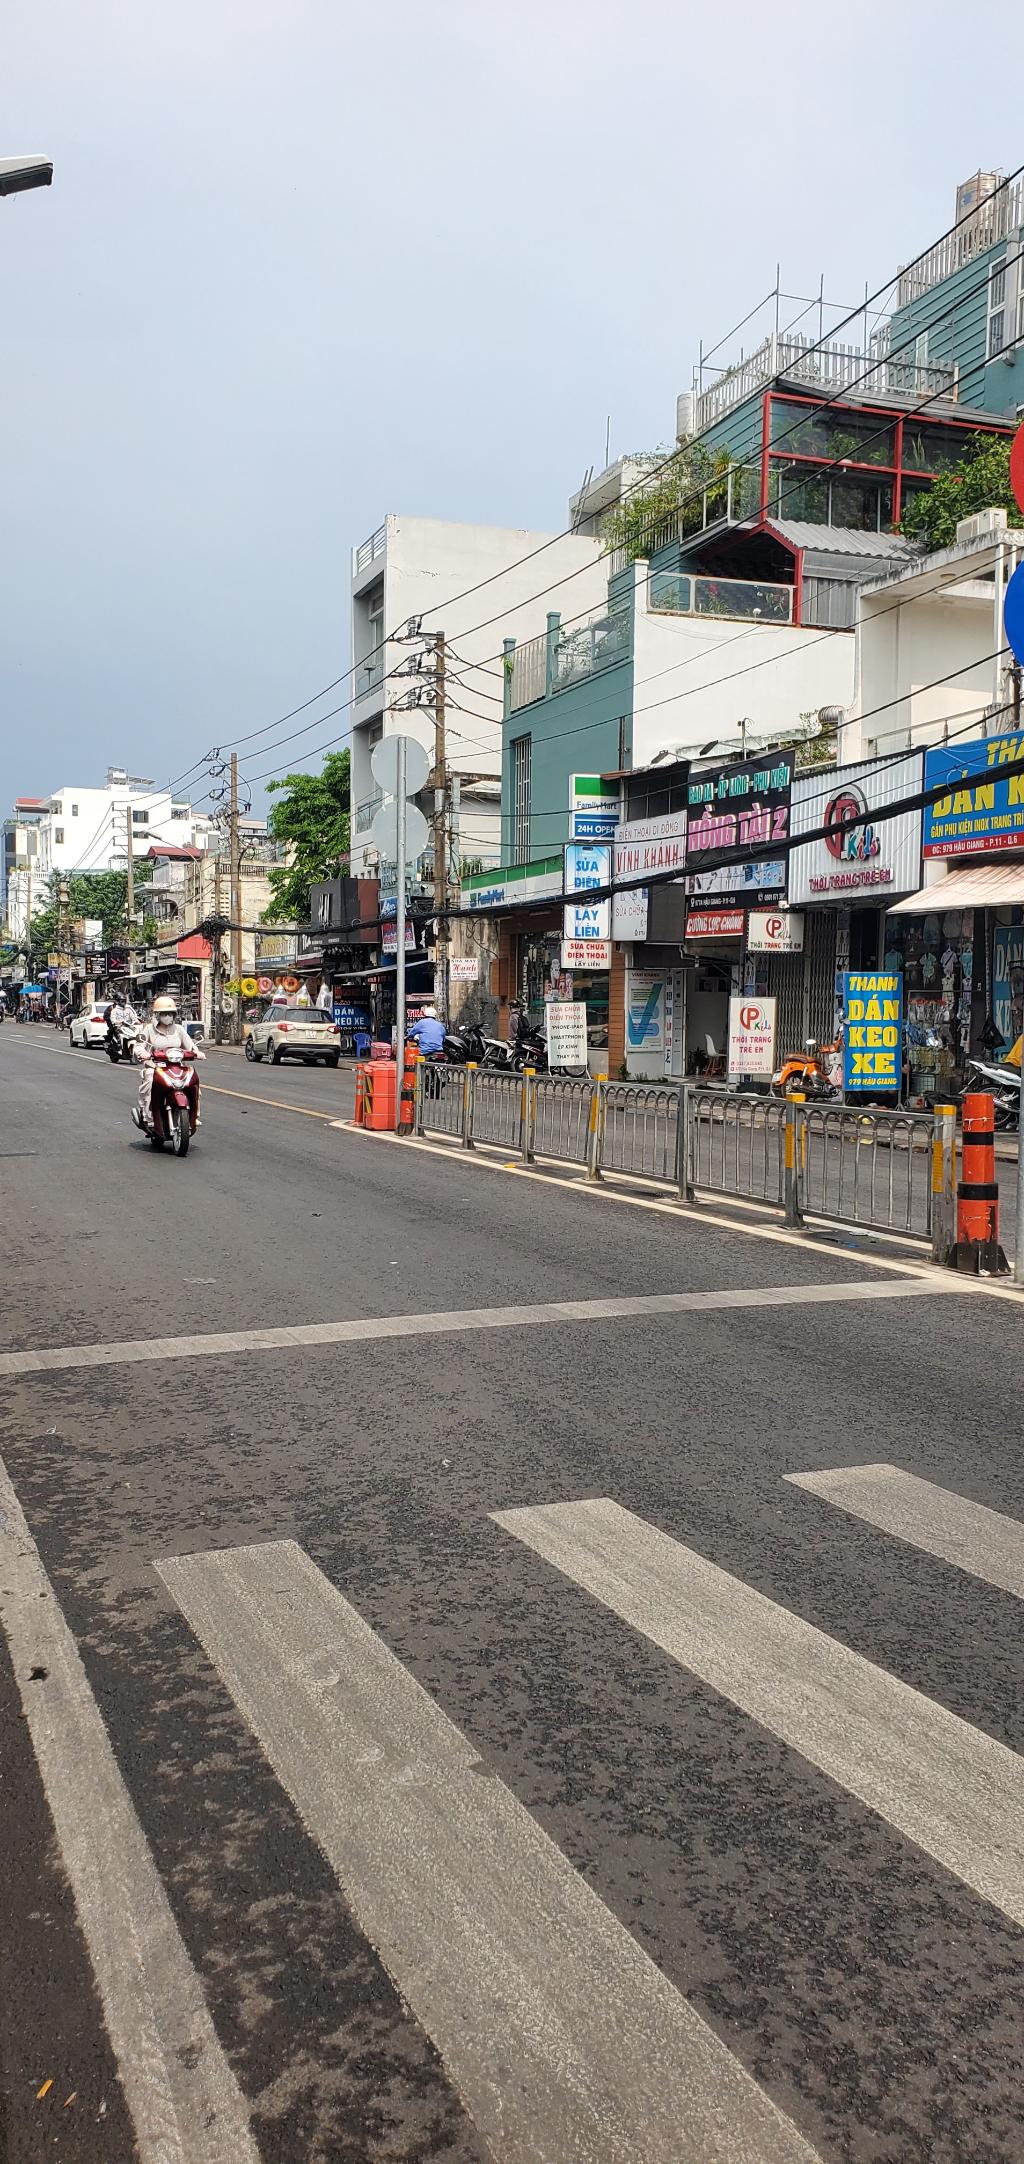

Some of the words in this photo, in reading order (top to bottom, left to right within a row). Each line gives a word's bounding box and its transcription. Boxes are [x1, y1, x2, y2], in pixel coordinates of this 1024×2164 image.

[576, 801, 617, 810] FamilyMart
[578, 825, 593, 833] 24H
[688, 804, 737, 852] HỒNG
[739, 803, 771, 844] TÀI
[772, 806, 788, 840] 2
[945, 822, 957, 837] PHỤ
[974, 818, 989, 832] INOX
[991, 815, 1011, 830] TRANG
[943, 841, 953, 852] 979
[954, 840, 965, 852] HẬU
[966, 838, 984, 849] GIANG
[989, 837, 1002, 846] P.11
[1008, 835, 1018, 844] Q.6
[617, 847, 639, 873] VĨNH
[644, 843, 679, 869] KHÁNH
[830, 872, 859, 887] TRANG
[849, 977, 898, 991] THANH
[334, 1007, 354, 1015] DÁN
[848, 994, 899, 1020] DÁN
[354, 1017, 365, 1025] XE
[848, 1027, 898, 1047] KEO
[852, 1053, 895, 1073] XE
[862, 1077, 876, 1085] HẬU
